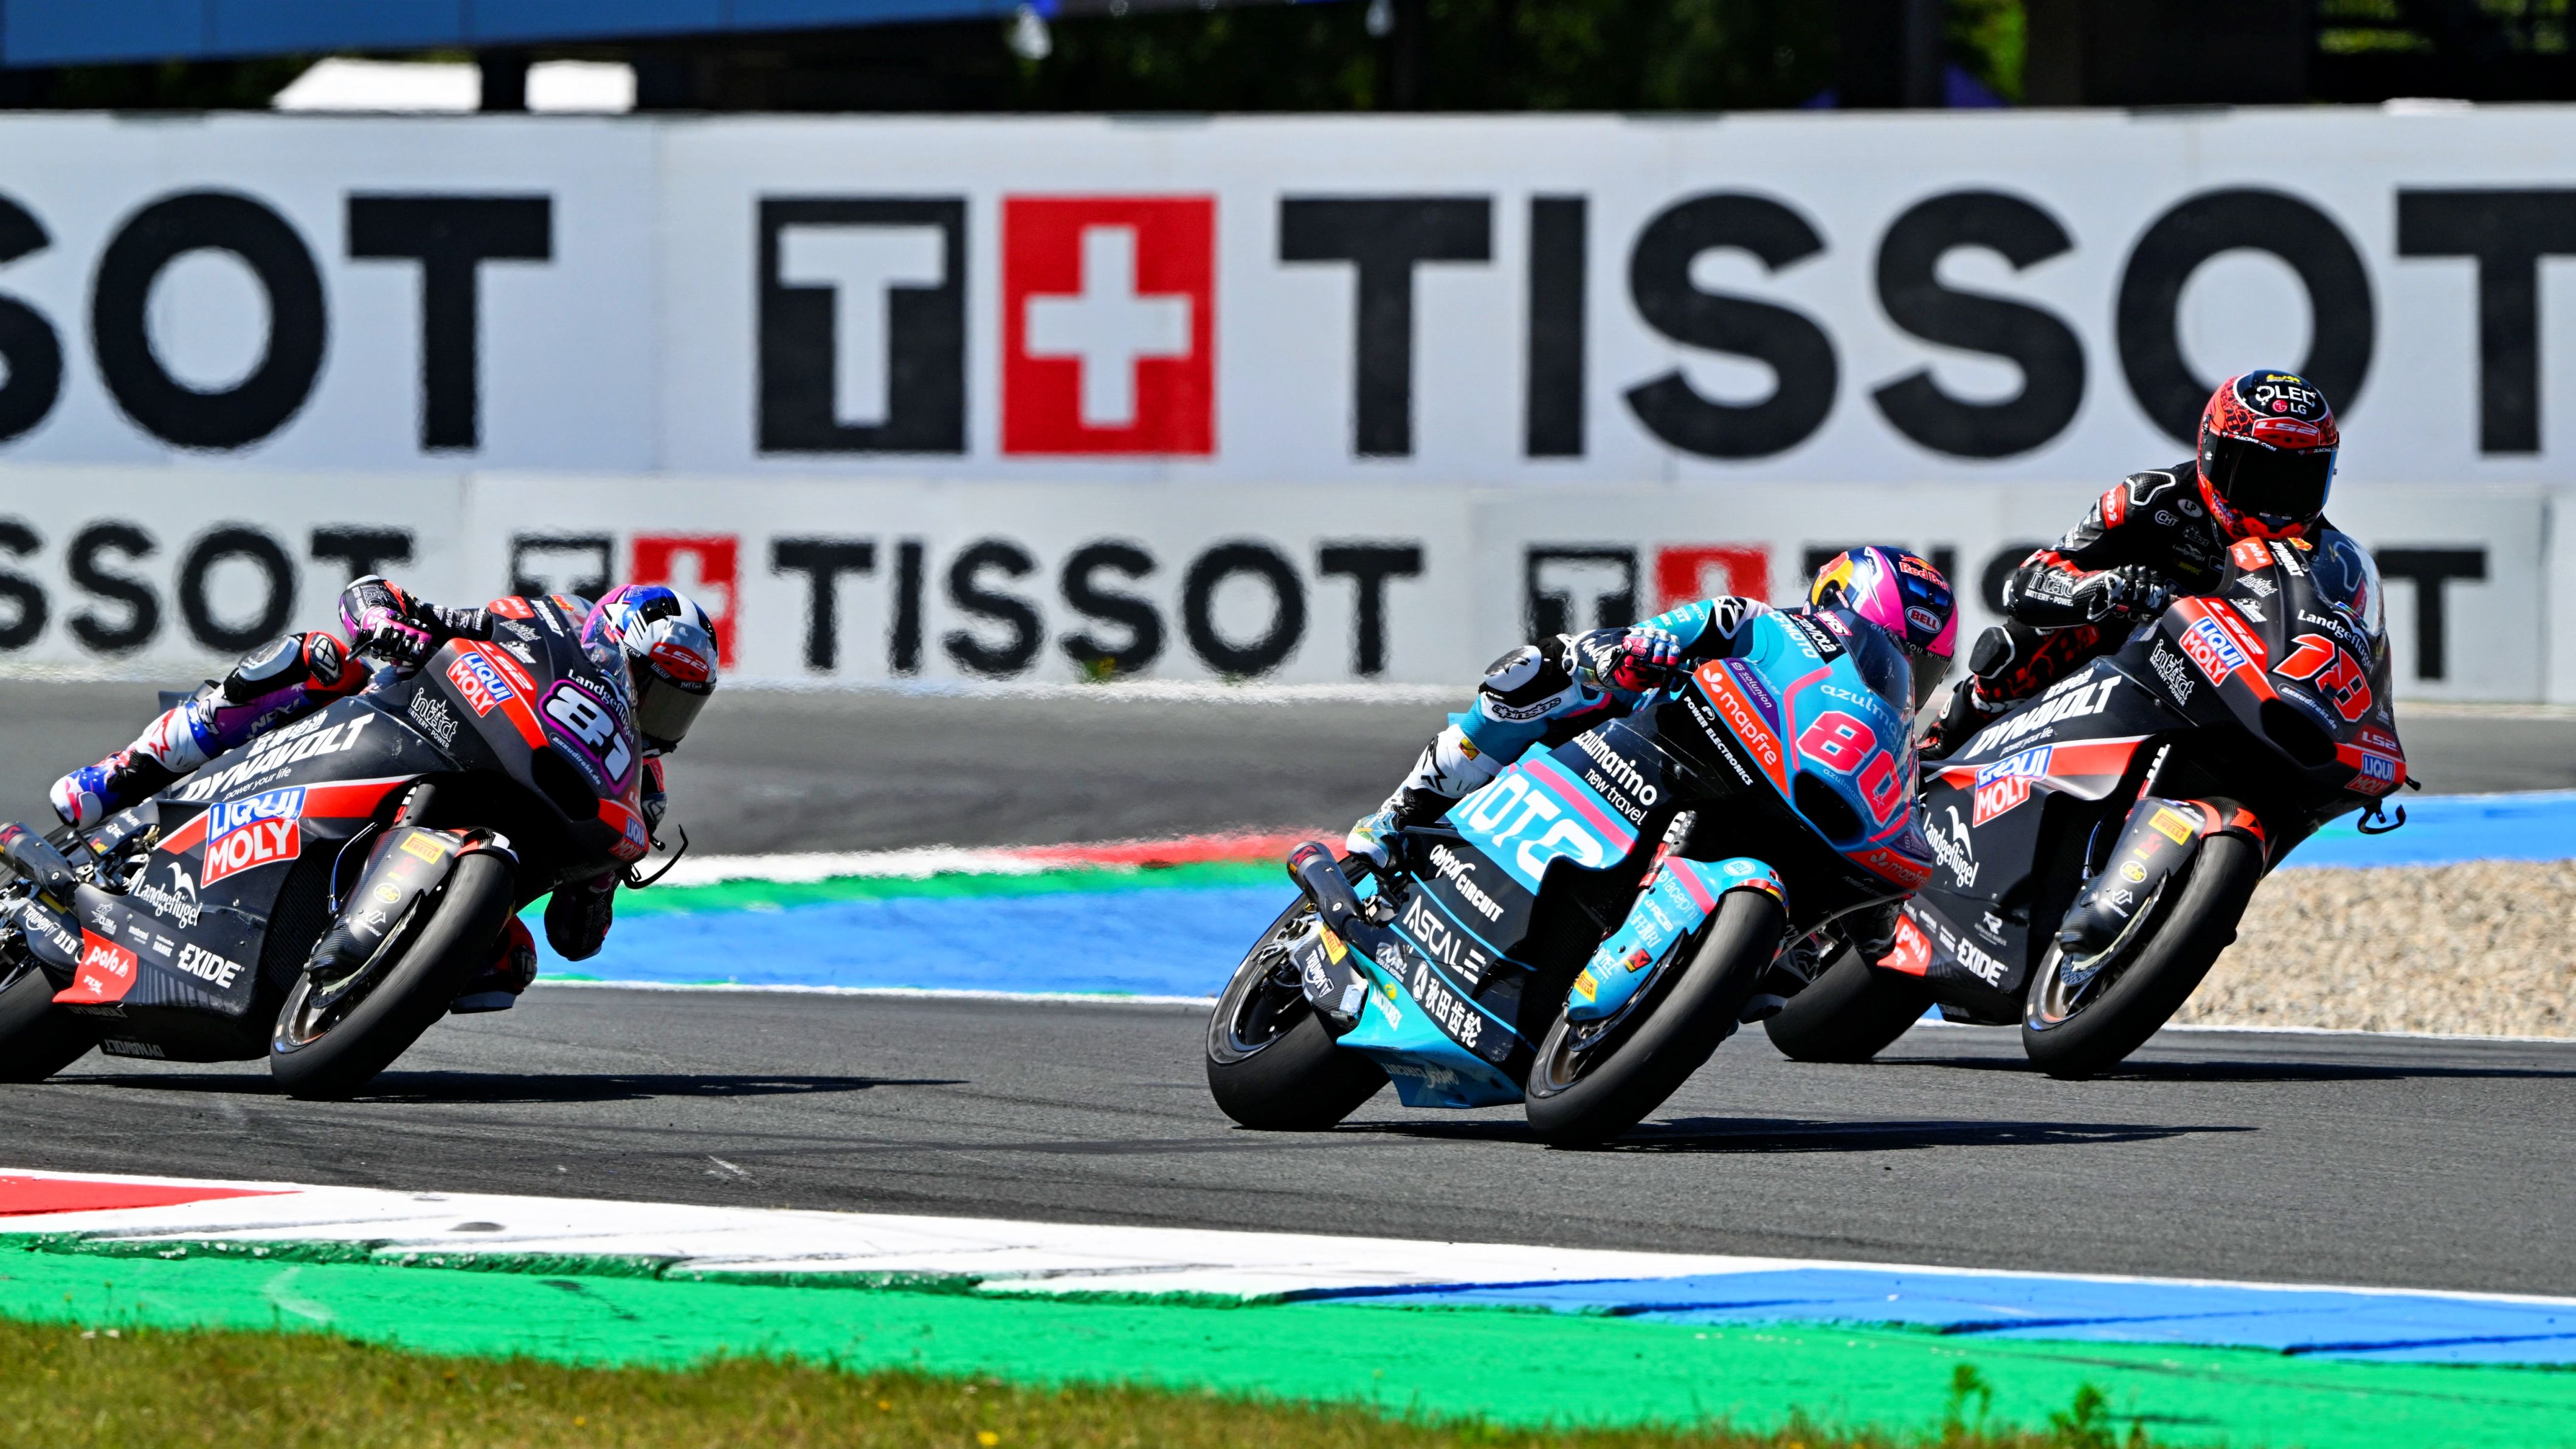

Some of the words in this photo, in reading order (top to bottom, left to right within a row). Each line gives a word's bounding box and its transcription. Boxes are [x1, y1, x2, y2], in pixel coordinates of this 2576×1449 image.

[1279, 188, 2576, 461] TISSOT
[2256, 421, 2319, 436] LS2
[2290, 401, 2307, 415] LG
[2184, 500, 2197, 512] LP
[1899, 561, 1929, 580] Red
[772, 538, 1424, 683] TISSOT
[1817, 611, 1850, 635] WRS
[1910, 608, 1938, 630] BELL
[2208, 601, 2265, 655] LS2
[1767, 611, 1819, 659] CFMOTO
[2183, 632, 2228, 680] MOLY
[2193, 620, 2245, 667] LIQUI
[464, 654, 511, 700] LIQUI
[478, 642, 534, 691] LS2
[653, 645, 710, 673] LS2
[450, 662, 496, 711] MOLY
[568, 669, 634, 744] Landgeflügel
[1491, 697, 1562, 721] alpinestars
[1741, 671, 1773, 708] solunion
[546, 685, 632, 783] 81
[1683, 696, 1709, 728] POWER
[1705, 727, 1754, 786] ELECTRONICS
[1719, 691, 1777, 766] mapfre
[1964, 675, 2122, 760] DYNAVOLT
[179, 713, 375, 800] DYNAVOLT
[552, 736, 601, 786] akkudirekt.de
[2363, 731, 2398, 752] LS2
[222, 782, 254, 802] power
[250, 774, 276, 792] your
[275, 766, 292, 780] life
[1796, 710, 1902, 828] 80
[2364, 757, 2394, 781] LIQUI
[210, 790, 300, 842] LIQUI
[1584, 768, 1610, 793] new
[1608, 786, 1648, 826] travel
[1977, 776, 2026, 821] MOLY
[205, 819, 295, 882] MOLY
[406, 837, 440, 859] PIRELLI
[626, 819, 645, 847] LIQUI
[22, 904, 52, 932] TRIUMPH
[134, 876, 204, 929] Landgeflügel
[1455, 874, 1505, 922] CIRCUIT
[1662, 876, 1699, 921] facephi
[85, 946, 120, 972] polo
[1402, 894, 1487, 985] ASCALE
[1957, 937, 2006, 987] EXIDE
[177, 942, 242, 989] EXIDE
[1305, 949, 1327, 994] TRIUMPH
[1370, 985, 1403, 1032] MOTOREX
[1425, 977, 1482, 1048] 秋田齿轮
